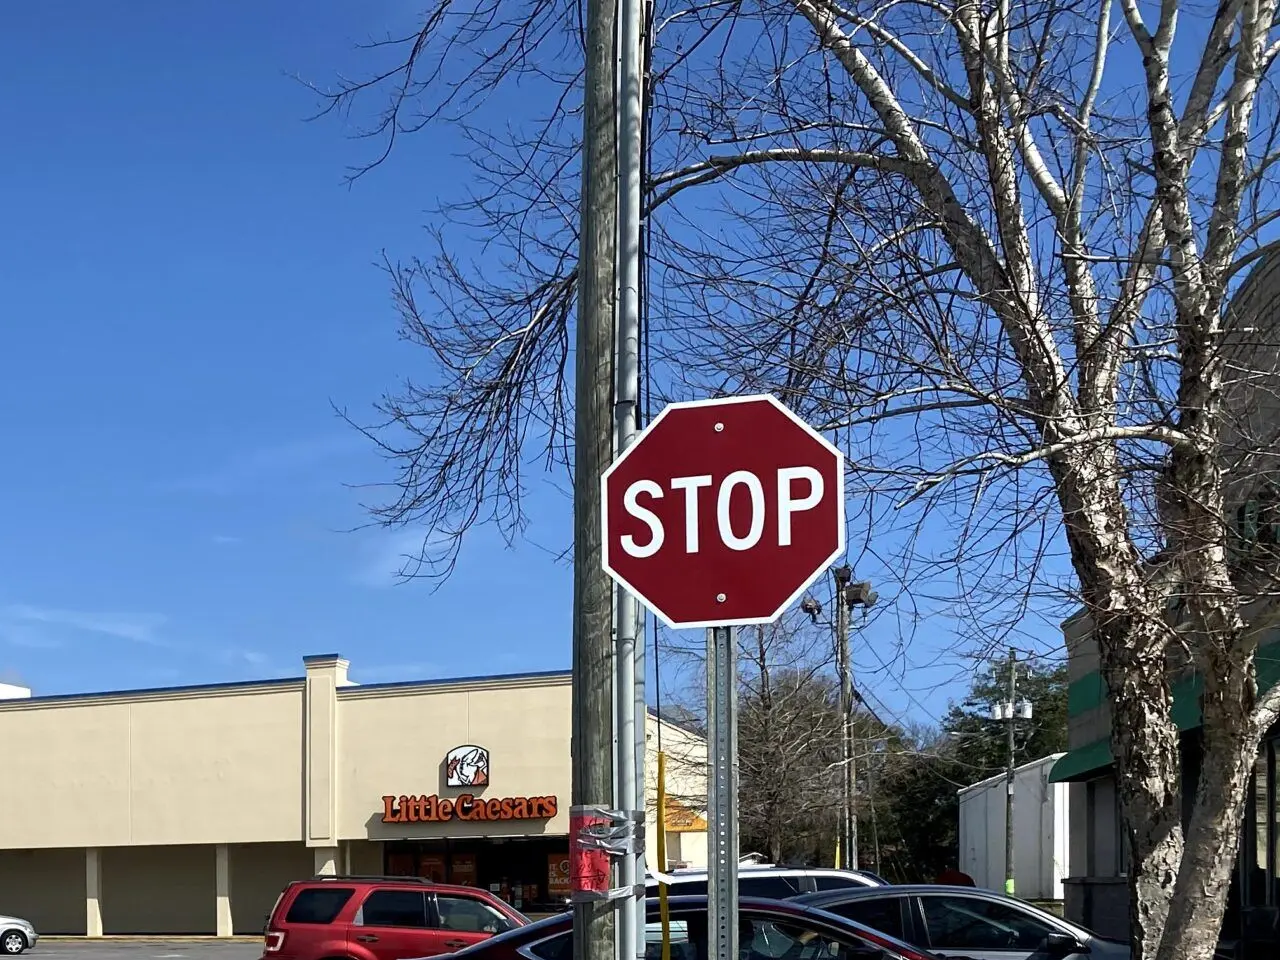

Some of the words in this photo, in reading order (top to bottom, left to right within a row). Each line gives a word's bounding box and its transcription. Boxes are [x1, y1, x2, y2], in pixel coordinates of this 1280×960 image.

[620, 465, 825, 559] STOP
[382, 794, 453, 823] Little
[455, 794, 558, 821] Caesars
